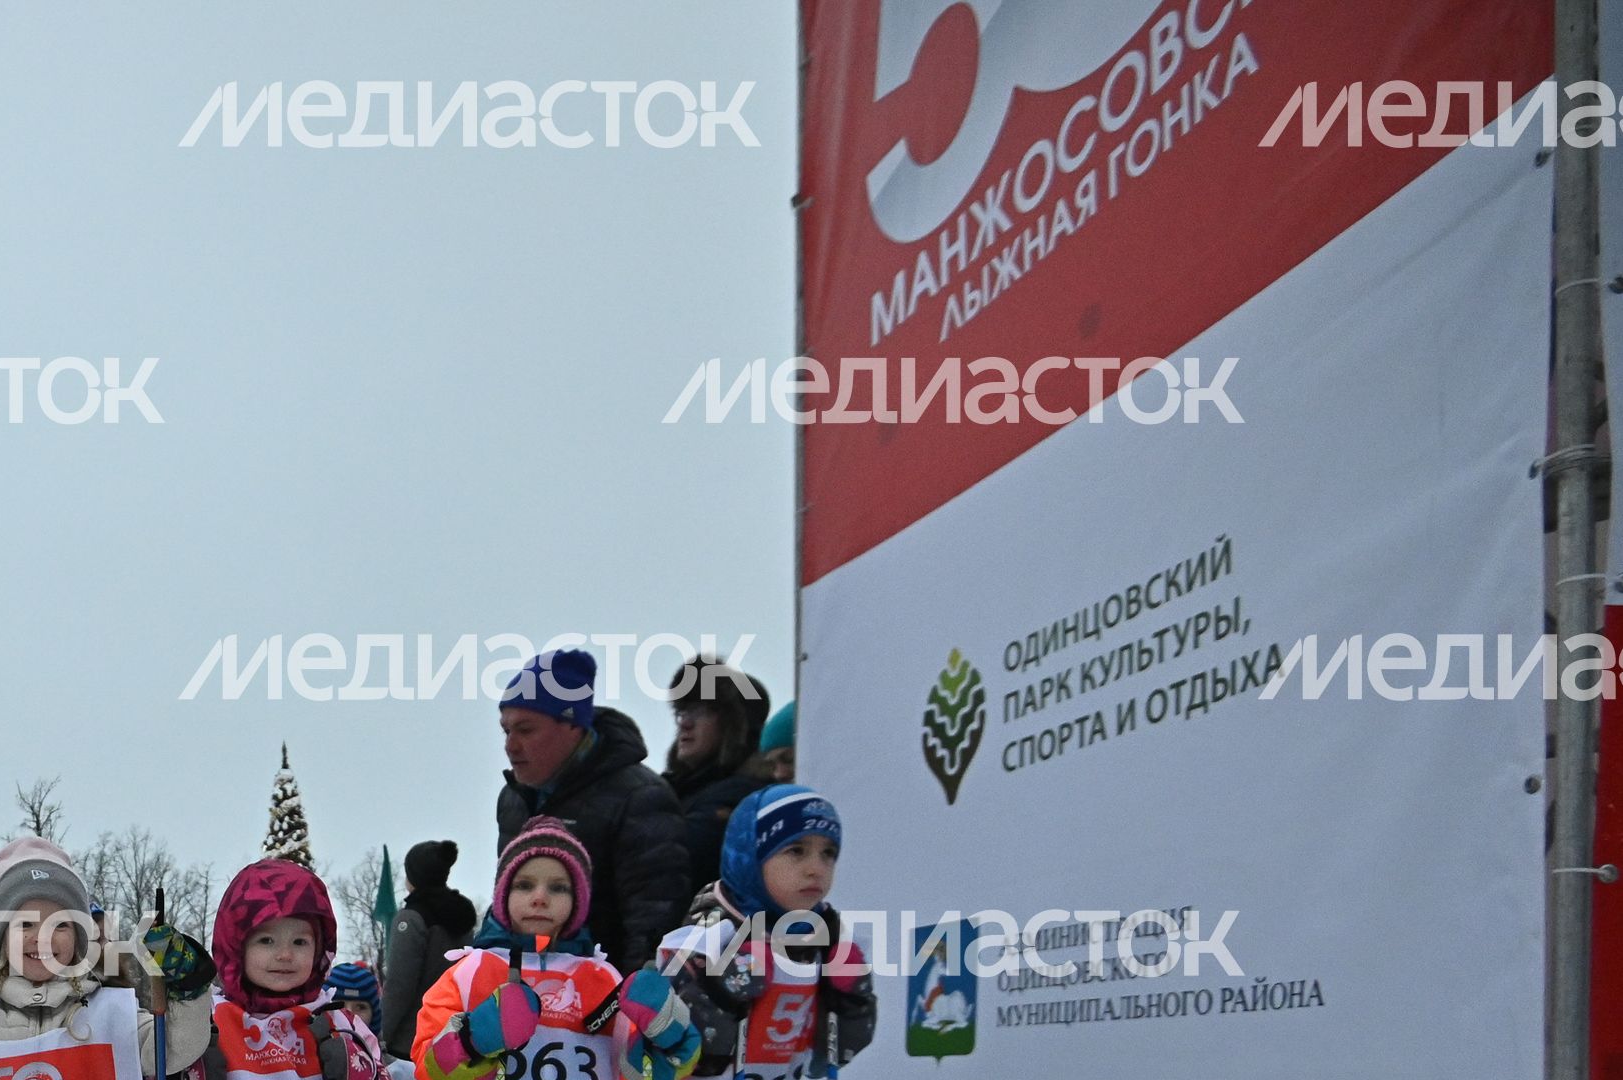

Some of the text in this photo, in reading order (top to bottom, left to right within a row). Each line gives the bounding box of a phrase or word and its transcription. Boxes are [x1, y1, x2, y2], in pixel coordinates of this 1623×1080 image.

[870, 0, 1254, 347] МАНЖОСОВС
[939, 32, 1259, 344] ЛЫЖНАЯ ГОНКА
[1003, 533, 1232, 673] ОДИНЦОВСКИЙ
[1003, 596, 1251, 723] ПАРК КУЛЬТУРЫ,
[1002, 643, 1285, 773] СПОРТА И ОТДЫХА
[996, 976, 1326, 1028] МУНИЦИПАЛЬНОГО РАЙОНА
